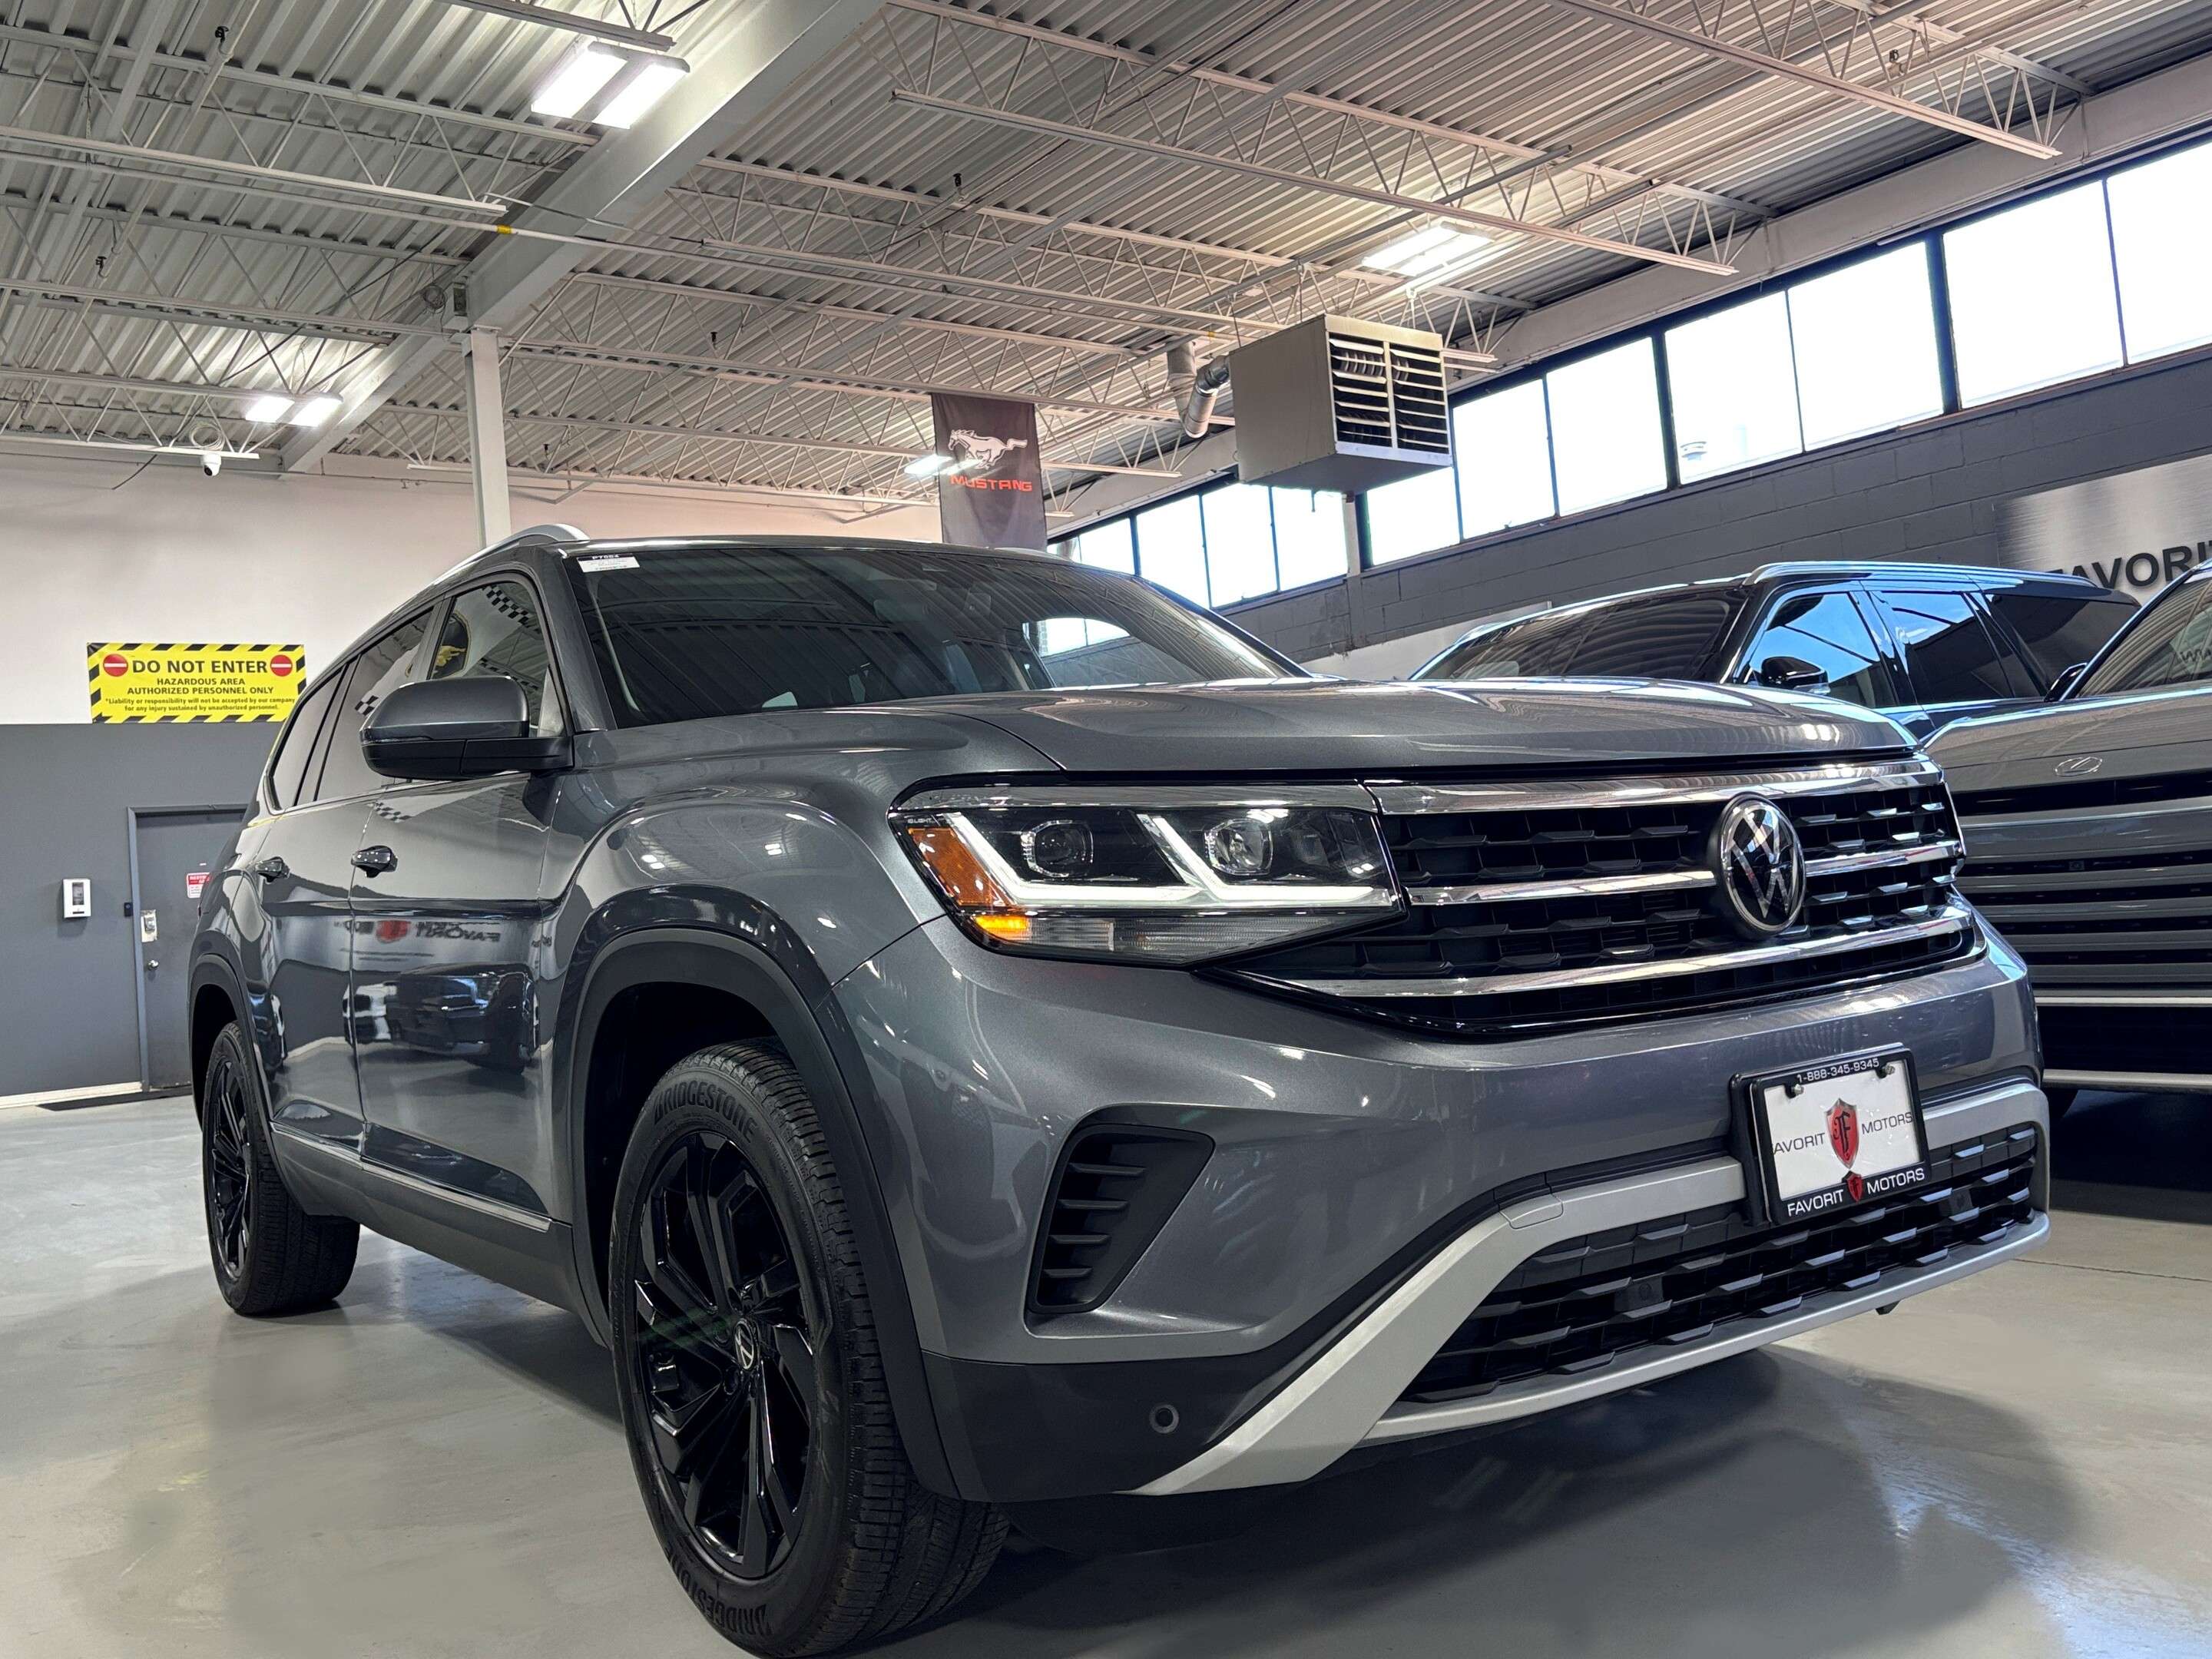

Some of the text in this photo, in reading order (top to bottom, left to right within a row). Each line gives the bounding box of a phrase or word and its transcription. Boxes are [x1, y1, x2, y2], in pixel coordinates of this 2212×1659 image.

[949, 475, 1032, 492] MUSTANG
[2044, 540, 2212, 590] VORI
[132, 661, 267, 673] DO NOT ENTER
[157, 677, 217, 686] HAZARDOUS
[1797, 1058, 1879, 1084] 1-888-345-9345
[654, 1080, 757, 1143] BRIDGESTONE
[1773, 1132, 1825, 1155] AVORIT
[1861, 1111, 1914, 1134] MOTORS
[1787, 1190, 1844, 1217] FAVORIT
[1866, 1167, 1925, 1194] MOTORS
